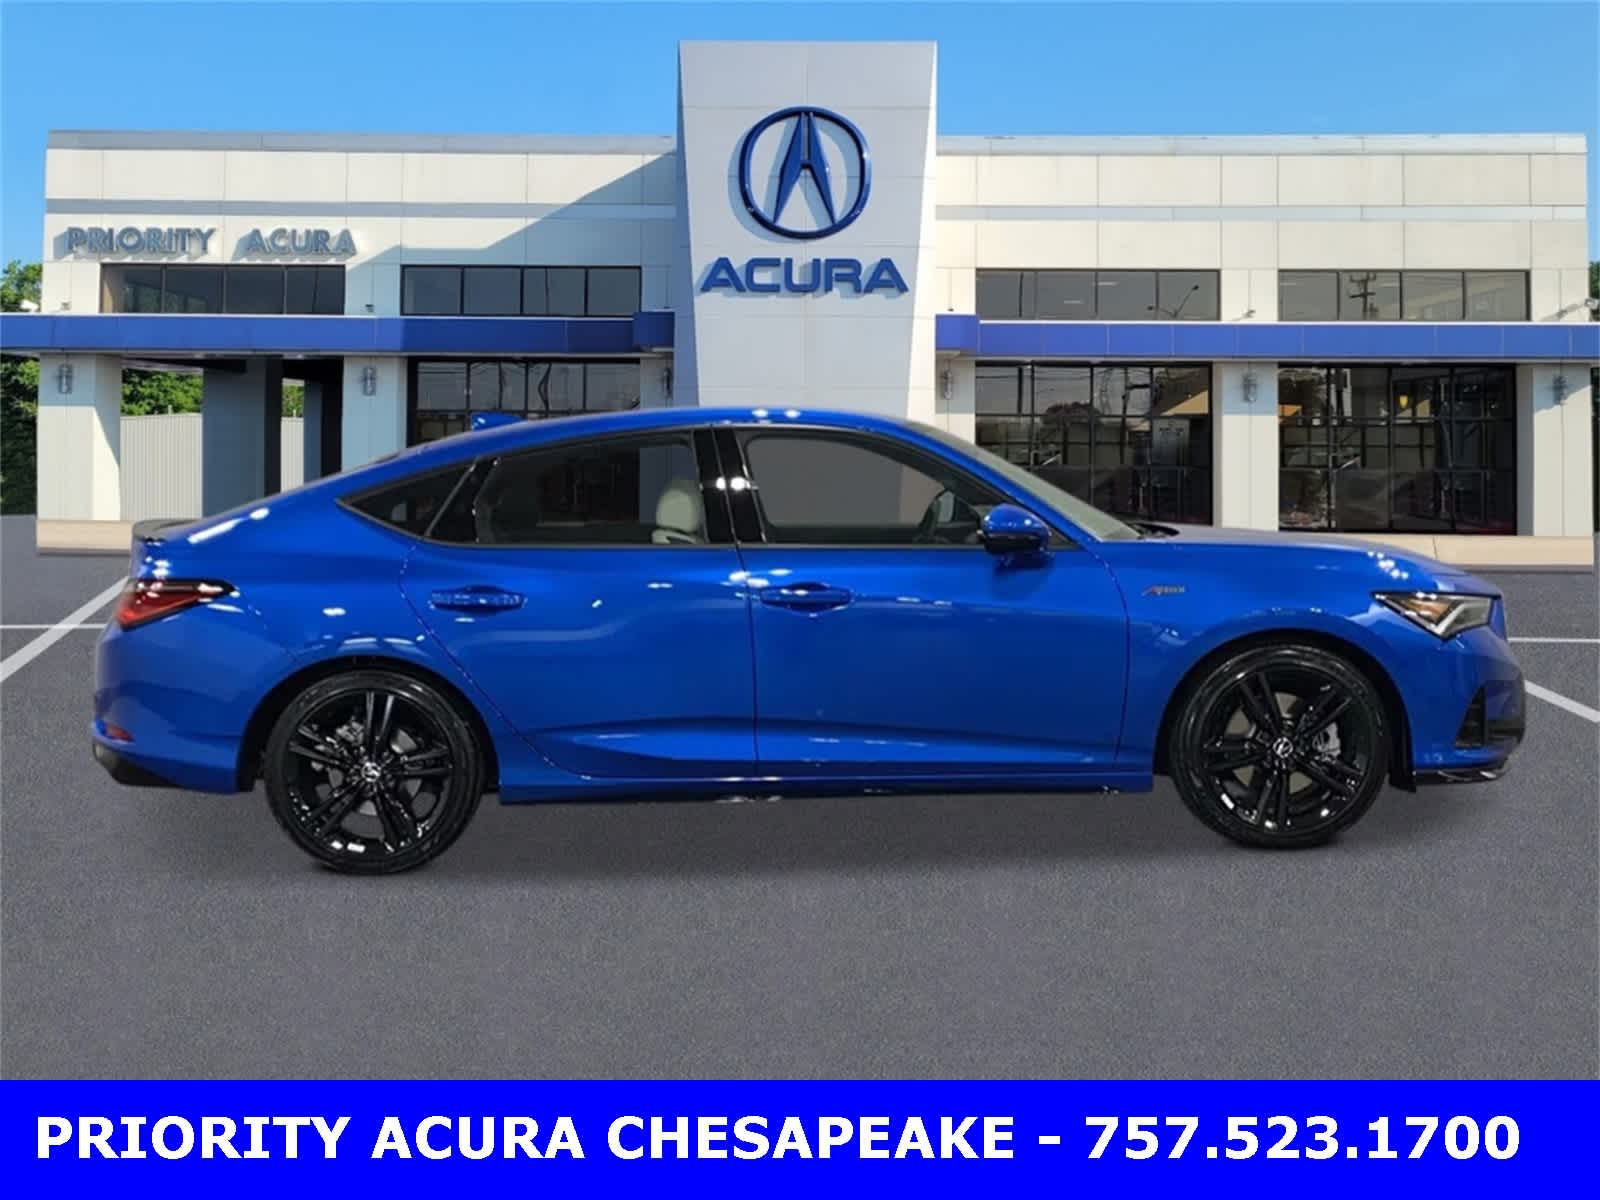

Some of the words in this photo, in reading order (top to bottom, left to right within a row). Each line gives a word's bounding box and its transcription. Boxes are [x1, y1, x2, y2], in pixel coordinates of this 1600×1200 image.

[66, 226, 216, 253] PRIORITY
[245, 227, 358, 256] ACURA
[700, 256, 909, 294] ACURA
